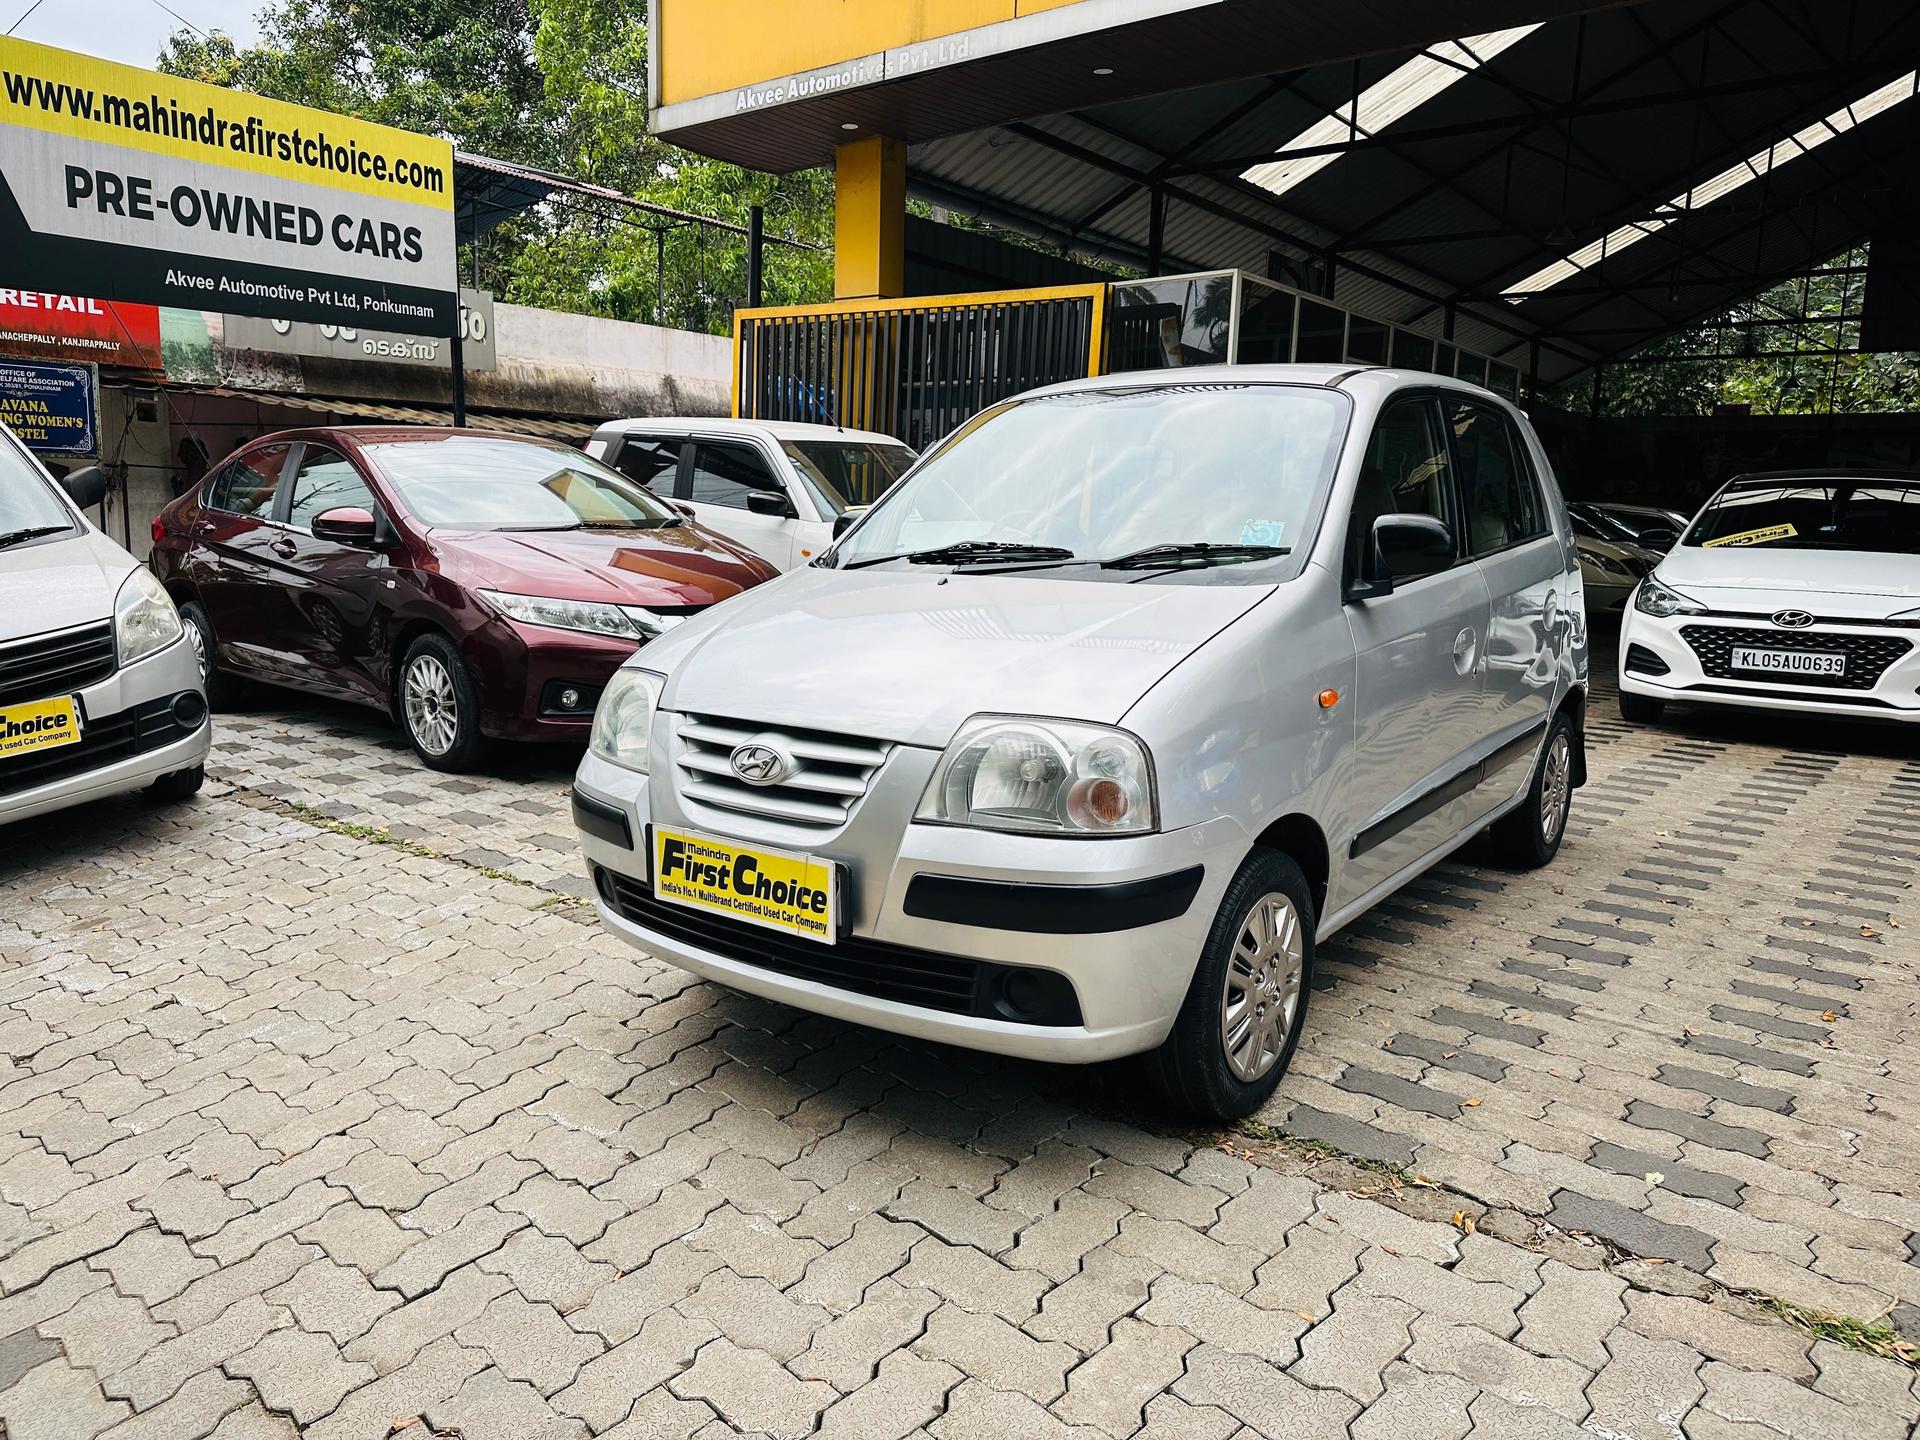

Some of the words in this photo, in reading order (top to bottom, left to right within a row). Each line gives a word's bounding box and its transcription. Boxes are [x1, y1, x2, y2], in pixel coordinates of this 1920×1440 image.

[736, 85, 784, 111] Akvee
[787, 59, 893, 99] Automotives
[899, 51, 935, 72] Pvt.
[938, 36, 975, 65] Ltd.
[3, 70, 444, 194] www.mahindrafirstchoice.com
[65, 164, 323, 247] PRE-OWNED
[332, 214, 424, 263] CARS
[0, 288, 104, 315] RETAIL
[165, 269, 215, 291] Akvee
[218, 275, 305, 303] Automotive
[308, 286, 331, 306] Pvt
[333, 288, 360, 312] Ltd,
[363, 295, 435, 319] Ponkunnam
[62, 336, 120, 351] KANJIRAPPALLY
[0, 369, 25, 377] OFFICE
[29, 378, 74, 387] ASSOCIATION
[0, 399, 48, 413] AVANA
[26, 414, 83, 428] WOMEN'S
[1741, 652, 1844, 673] KL05AU0639
[5, 740, 22, 749] used
[24, 737, 36, 745] Car
[38, 730, 71, 742] Company
[687, 843, 731, 862] Mahindra
[661, 837, 731, 890] First
[733, 854, 828, 914] Choice
[661, 880, 682, 895] India's
[683, 885, 697, 898] No.1
[698, 889, 732, 907] Multibrand
[733, 899, 762, 915] Certified
[763, 905, 780, 919] Used
[782, 911, 793, 922] Car
[795, 914, 828, 935] Company
